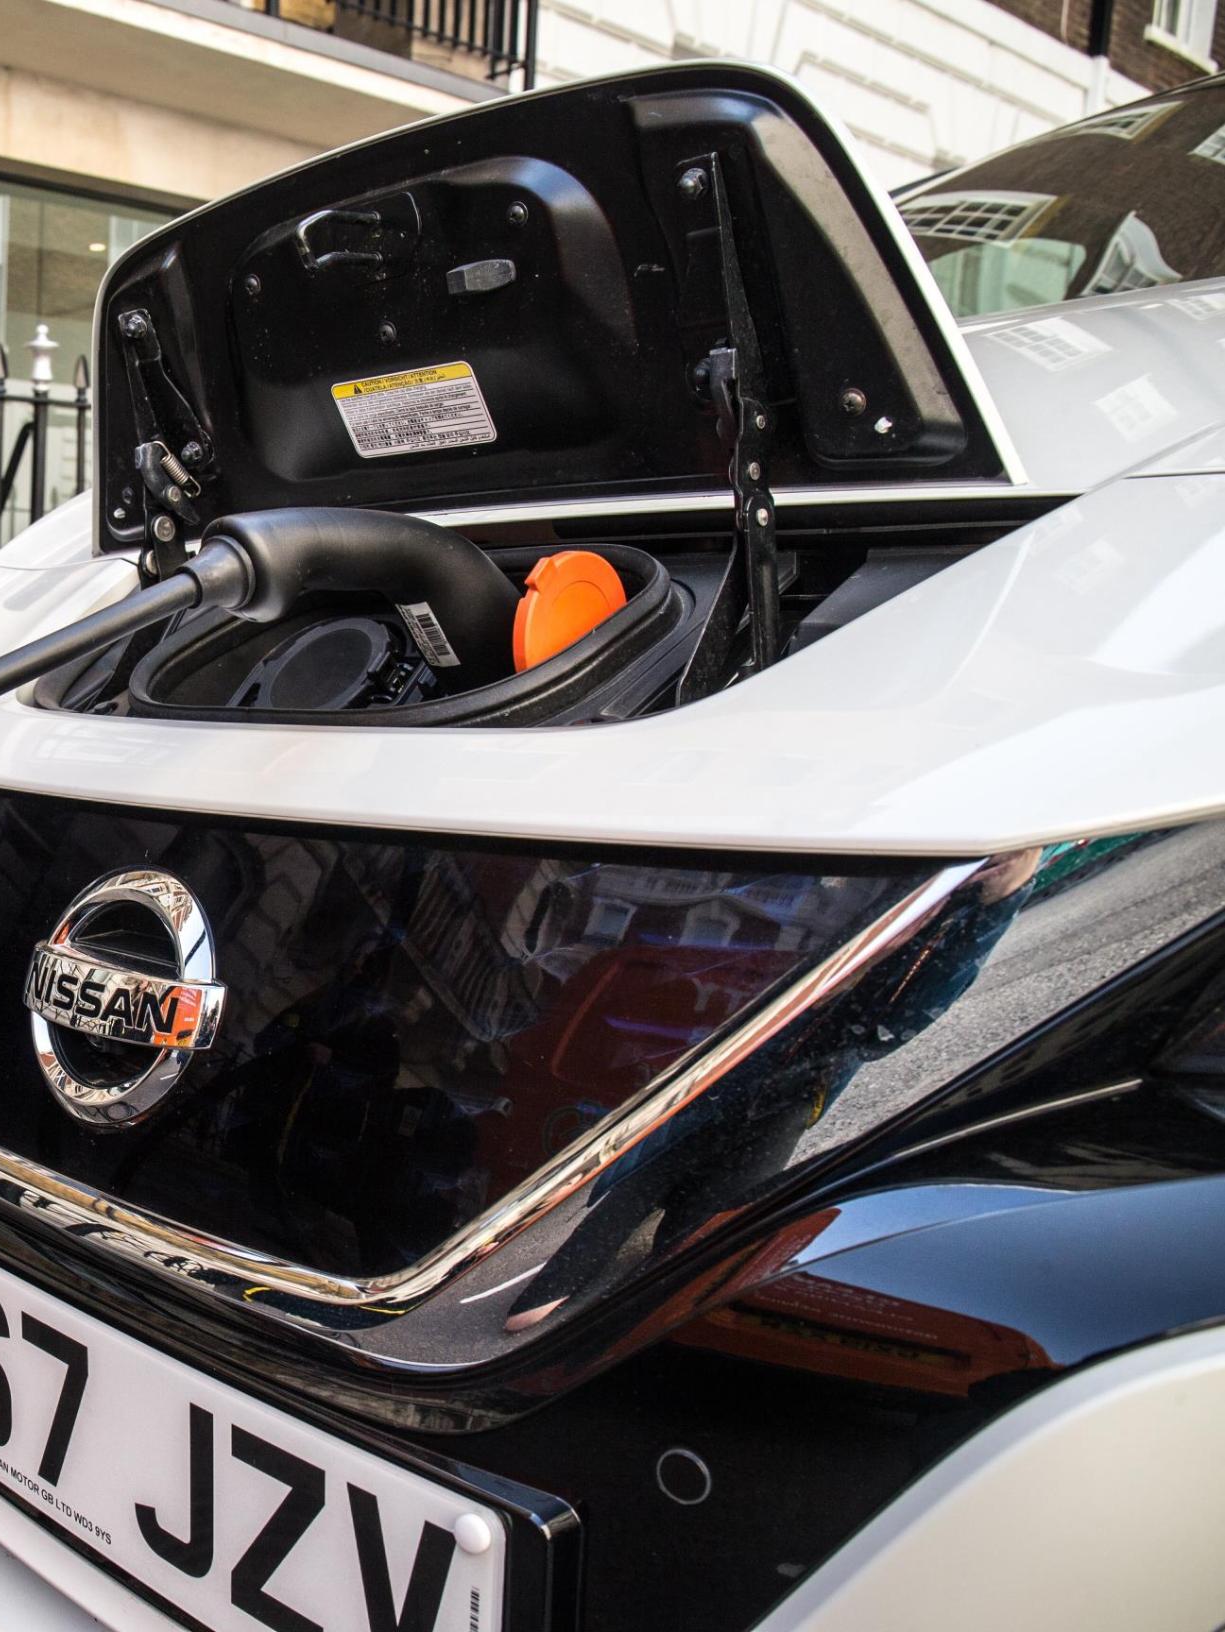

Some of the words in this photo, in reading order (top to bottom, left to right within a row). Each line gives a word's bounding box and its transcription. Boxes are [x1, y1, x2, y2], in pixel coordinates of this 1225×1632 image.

[26, 960, 179, 1034] NISSAN
[10, 1466, 40, 1496] MOTOR
[41, 1489, 54, 1505] GB
[55, 1498, 72, 1518] LTD
[74, 1510, 93, 1532] WD3
[95, 1526, 113, 1546] 9YS
[134, 1402, 458, 1632] JZV
